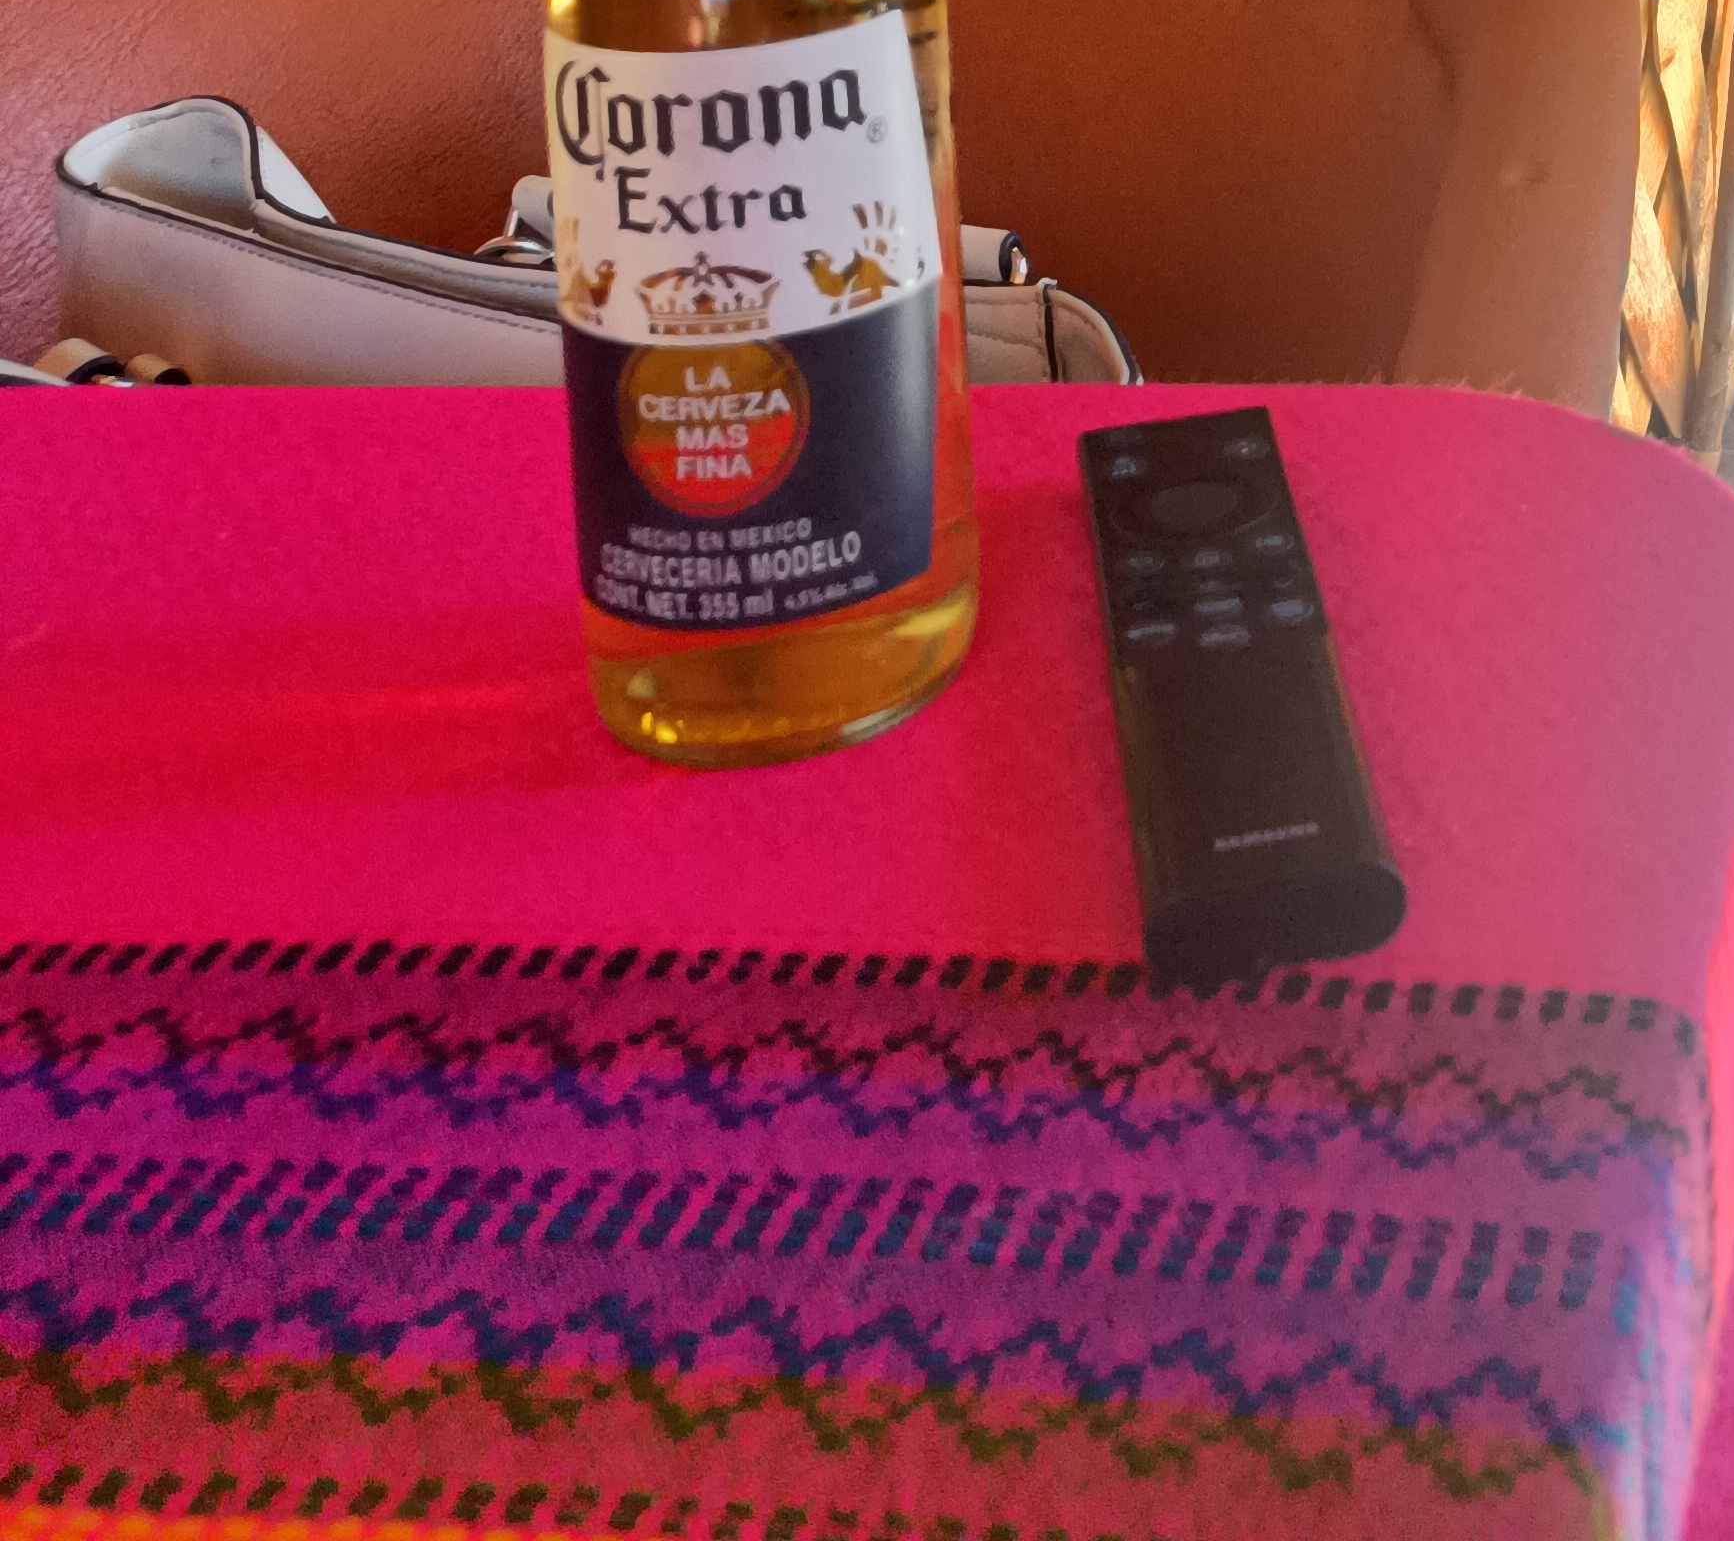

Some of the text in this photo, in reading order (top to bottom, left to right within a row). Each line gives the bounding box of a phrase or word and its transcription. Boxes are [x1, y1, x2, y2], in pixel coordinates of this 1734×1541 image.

[555, 59, 867, 182] Corona
[613, 165, 808, 235] Extra
[684, 364, 732, 393] LA
[637, 387, 793, 422] CERVEZA
[675, 423, 750, 451] MAS
[674, 451, 754, 482] FINA
[748, 530, 863, 583] MODELO
